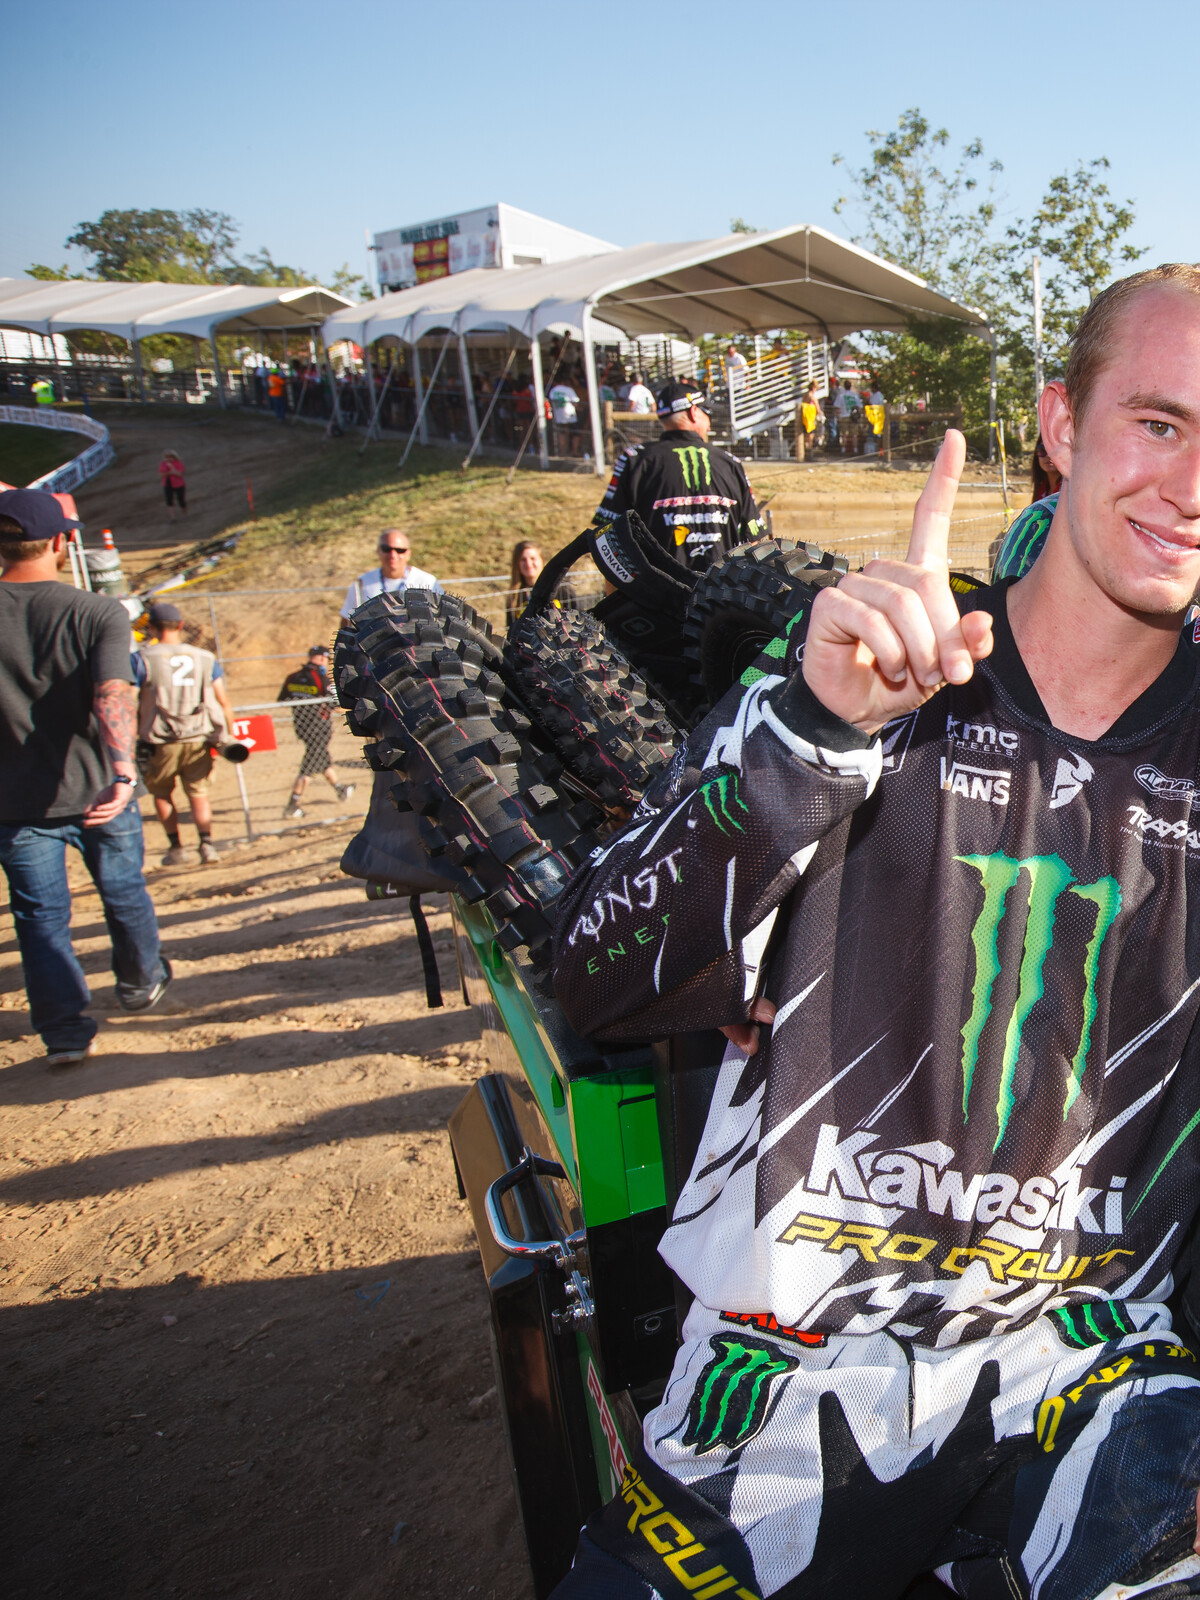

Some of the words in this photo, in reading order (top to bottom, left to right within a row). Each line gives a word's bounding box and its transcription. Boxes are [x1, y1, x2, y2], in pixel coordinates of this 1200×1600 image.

[664, 511, 730, 526] Kawasaki
[601, 544, 629, 581] WAYNEO
[170, 655, 195, 687] 2
[946, 715, 1019, 749] kmc
[940, 756, 1012, 806] VANS
[807, 1123, 1128, 1235] Kawaski
[782, 1213, 939, 1264] PRO
